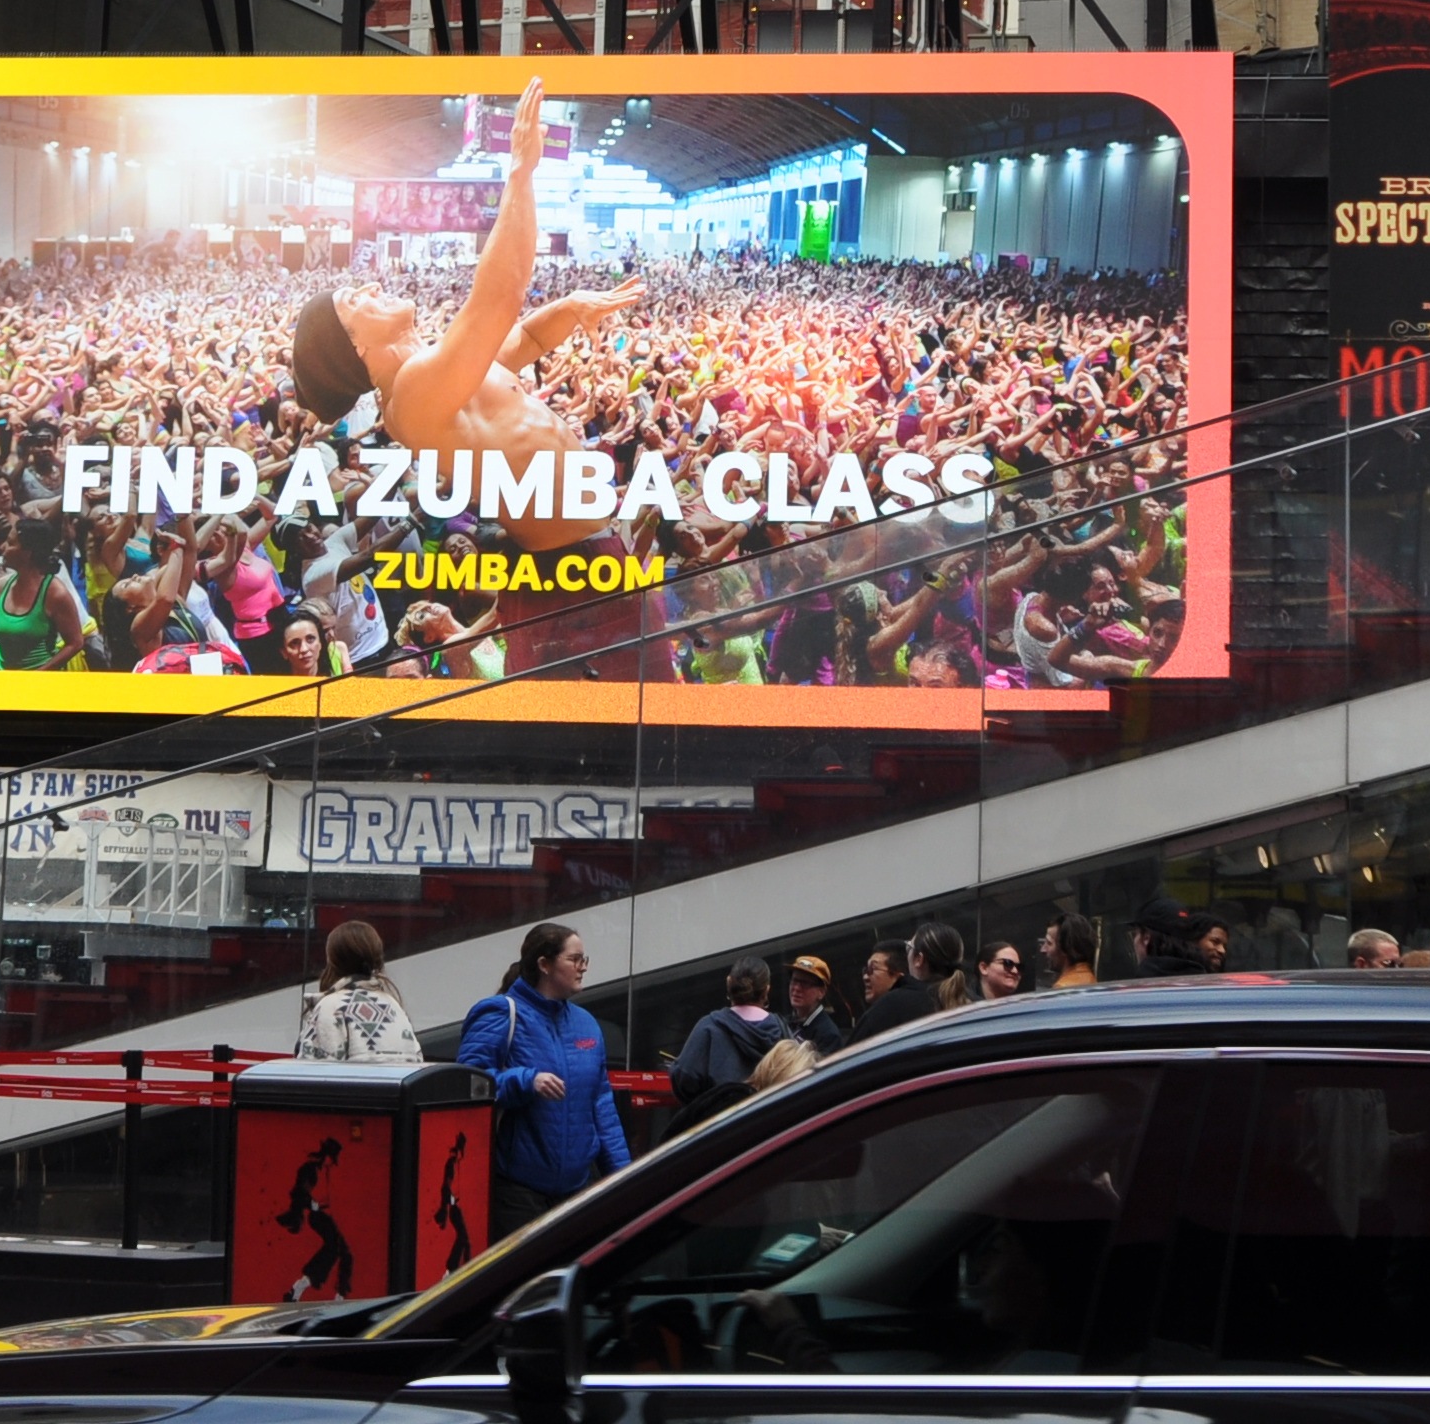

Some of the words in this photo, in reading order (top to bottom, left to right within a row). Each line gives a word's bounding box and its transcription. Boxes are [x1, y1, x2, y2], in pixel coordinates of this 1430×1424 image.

[62, 446, 269, 514] FIND
[273, 448, 339, 516] A
[355, 448, 682, 522] ZUMBA
[704, 451, 997, 524] CLASS
[372, 551, 665, 593] ZUMBA.COM
[30, 772, 77, 797] FAN
[84, 773, 144, 799] SHOP
[117, 809, 141, 823] NETS
[300, 787, 548, 868] GRAND
[103, 845, 149, 856] OFFICIALLY
